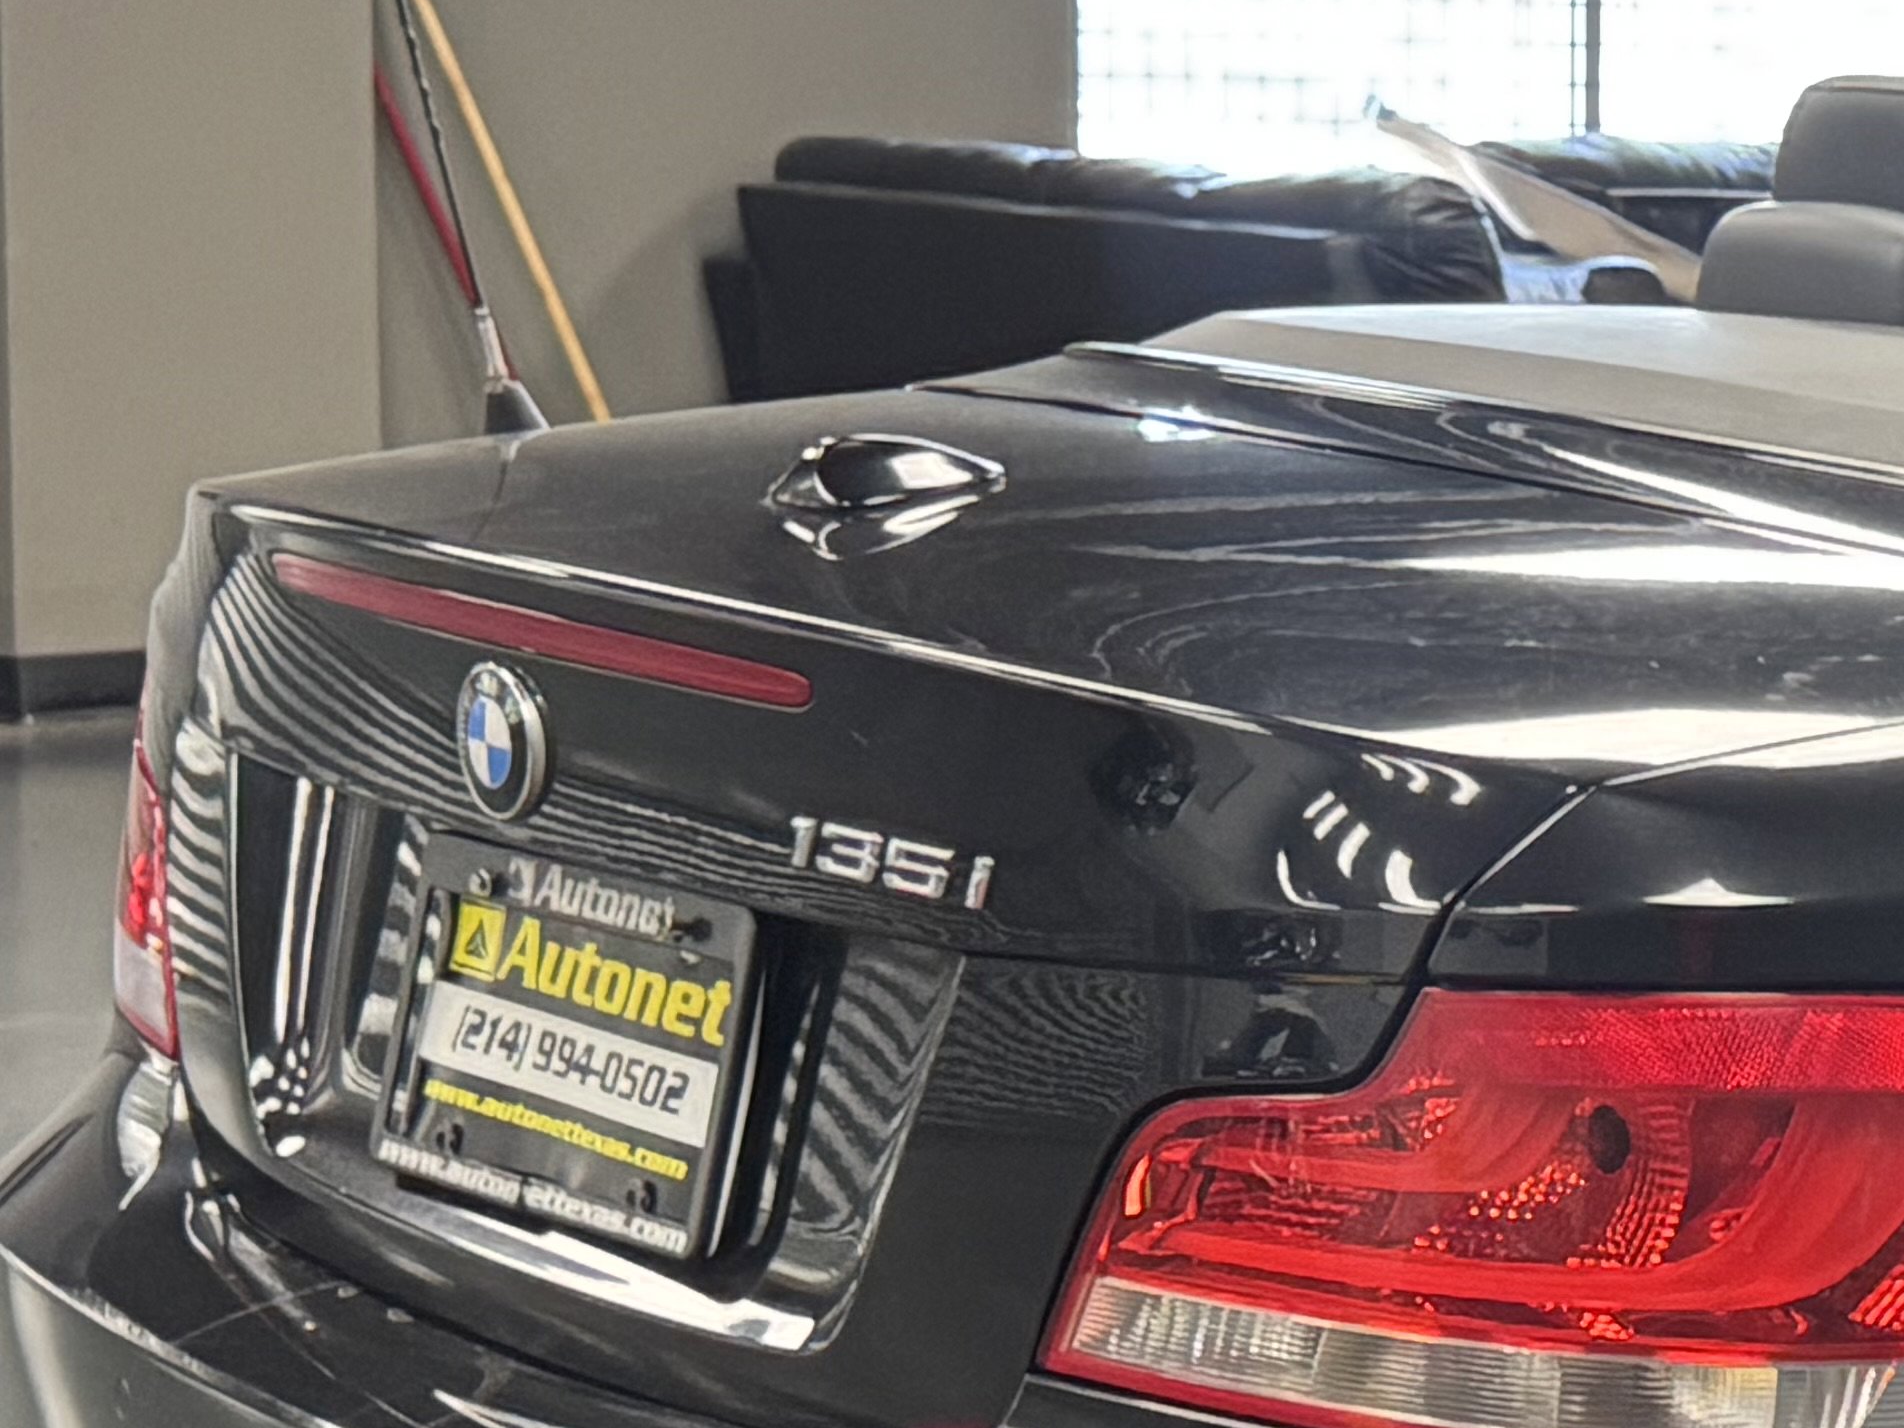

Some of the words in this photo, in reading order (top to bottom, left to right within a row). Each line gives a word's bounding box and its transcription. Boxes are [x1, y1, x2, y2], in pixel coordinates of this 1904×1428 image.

[534, 862, 676, 938] Autonet
[790, 815, 995, 910] 135i
[496, 917, 733, 1047] Autonet
[452, 1004, 534, 1071] (214)
[533, 1030, 690, 1116] 994-0502
[424, 1078, 689, 1181] www.autonettexas.com
